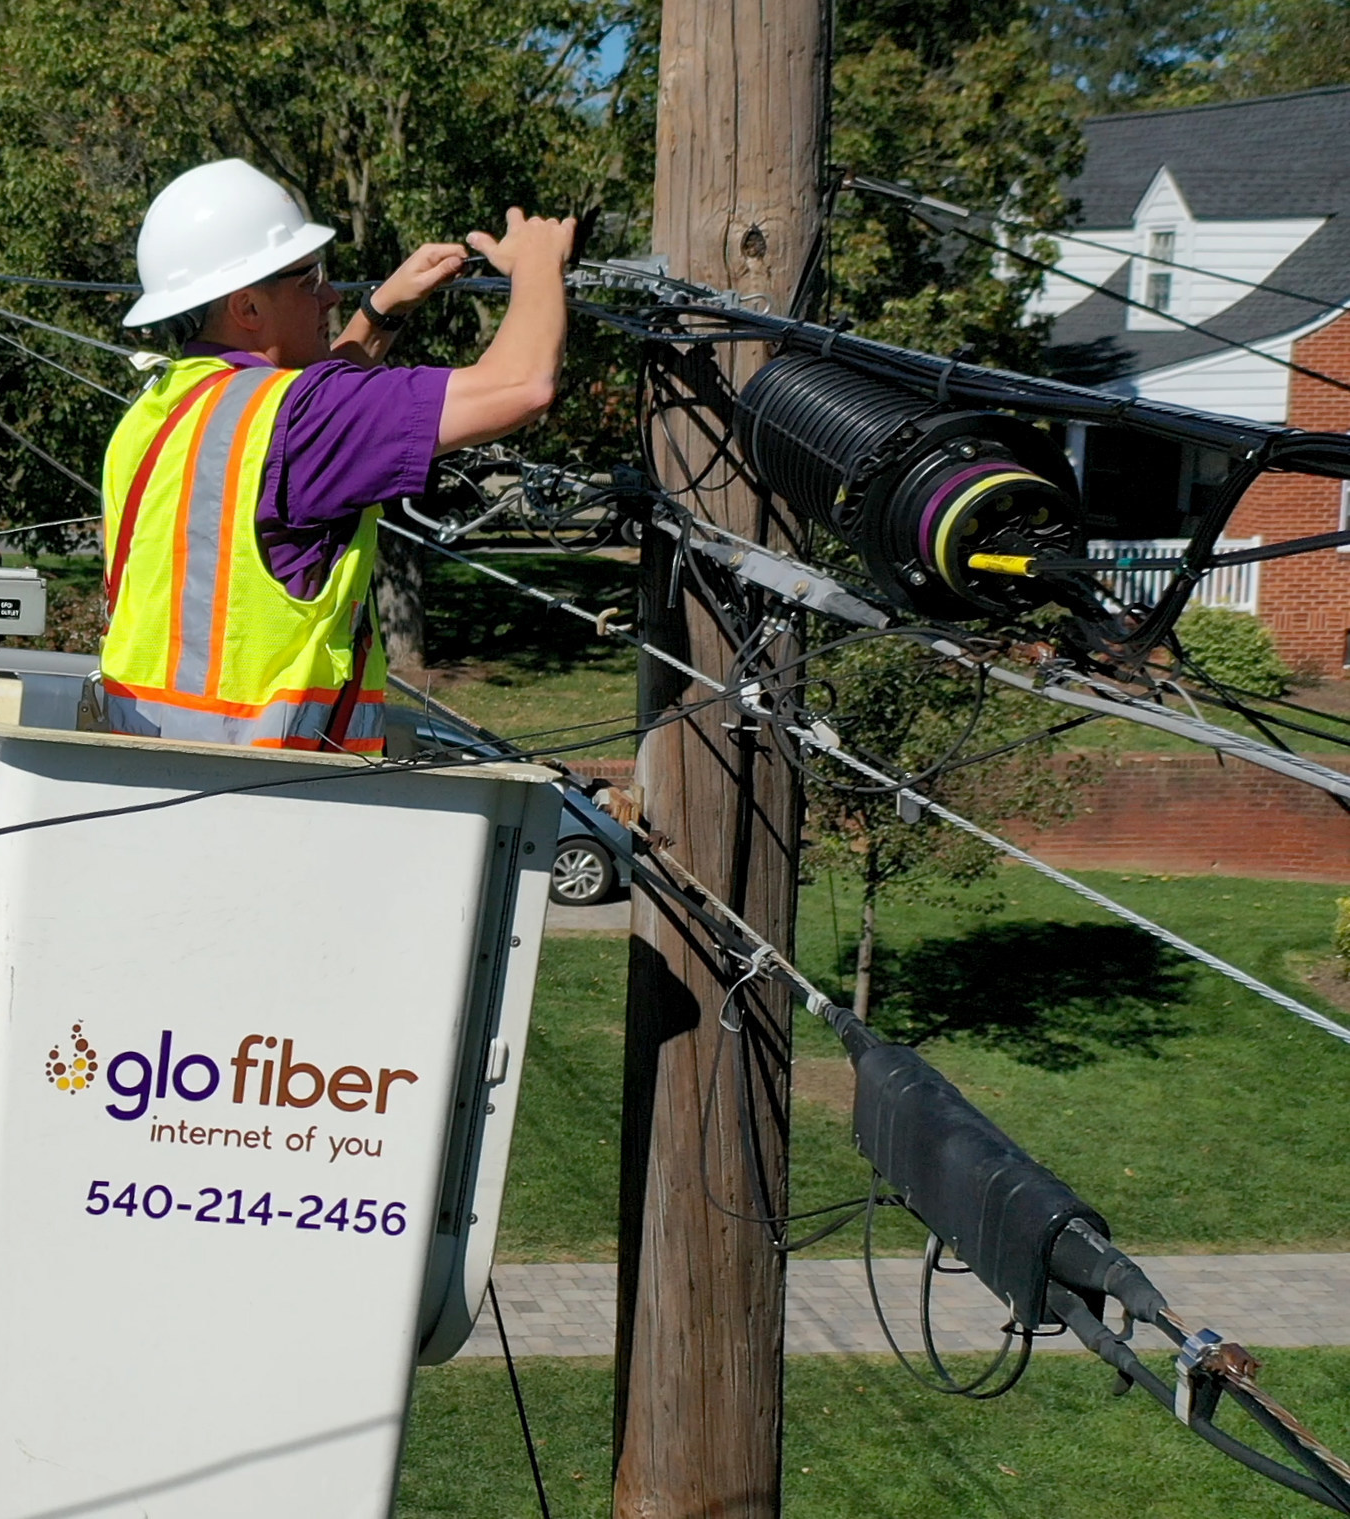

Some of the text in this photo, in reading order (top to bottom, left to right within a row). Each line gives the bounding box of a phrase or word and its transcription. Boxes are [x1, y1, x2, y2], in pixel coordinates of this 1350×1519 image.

[105, 1030, 419, 1121] glo fiber
[150, 1115, 383, 1163] internet of you
[85, 1180, 407, 1236] 540-214-2456
